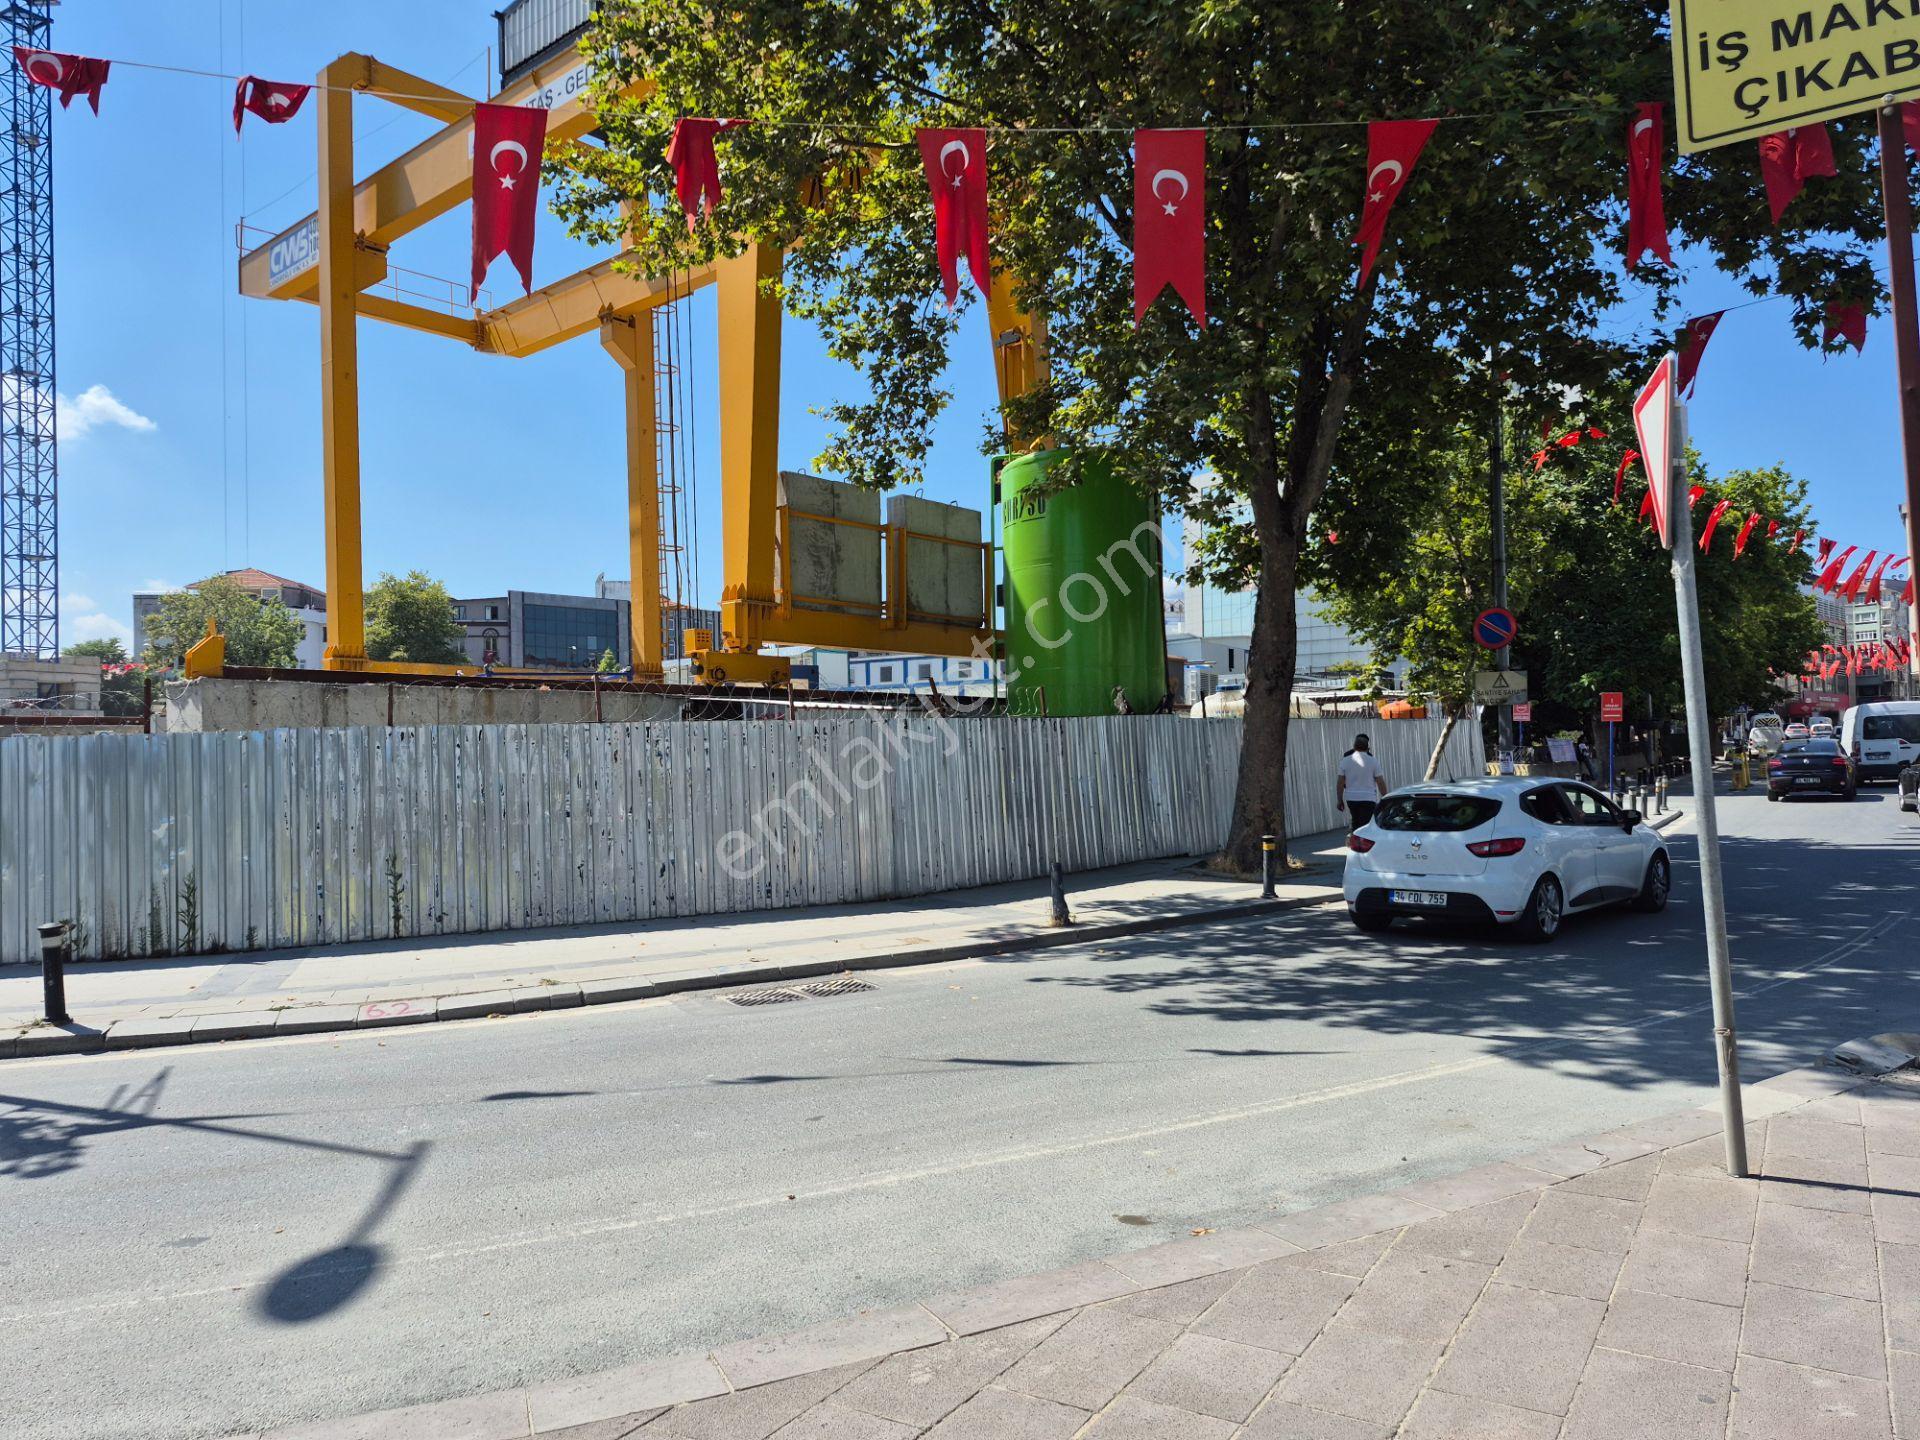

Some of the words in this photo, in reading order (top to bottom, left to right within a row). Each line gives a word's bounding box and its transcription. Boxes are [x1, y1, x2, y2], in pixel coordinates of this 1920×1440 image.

[1699, 31, 1749, 73] İŞ
[1734, 39, 1920, 119] ÇIKAB
[1394, 891, 1405, 902] 34
[1428, 893, 1445, 905] 755
